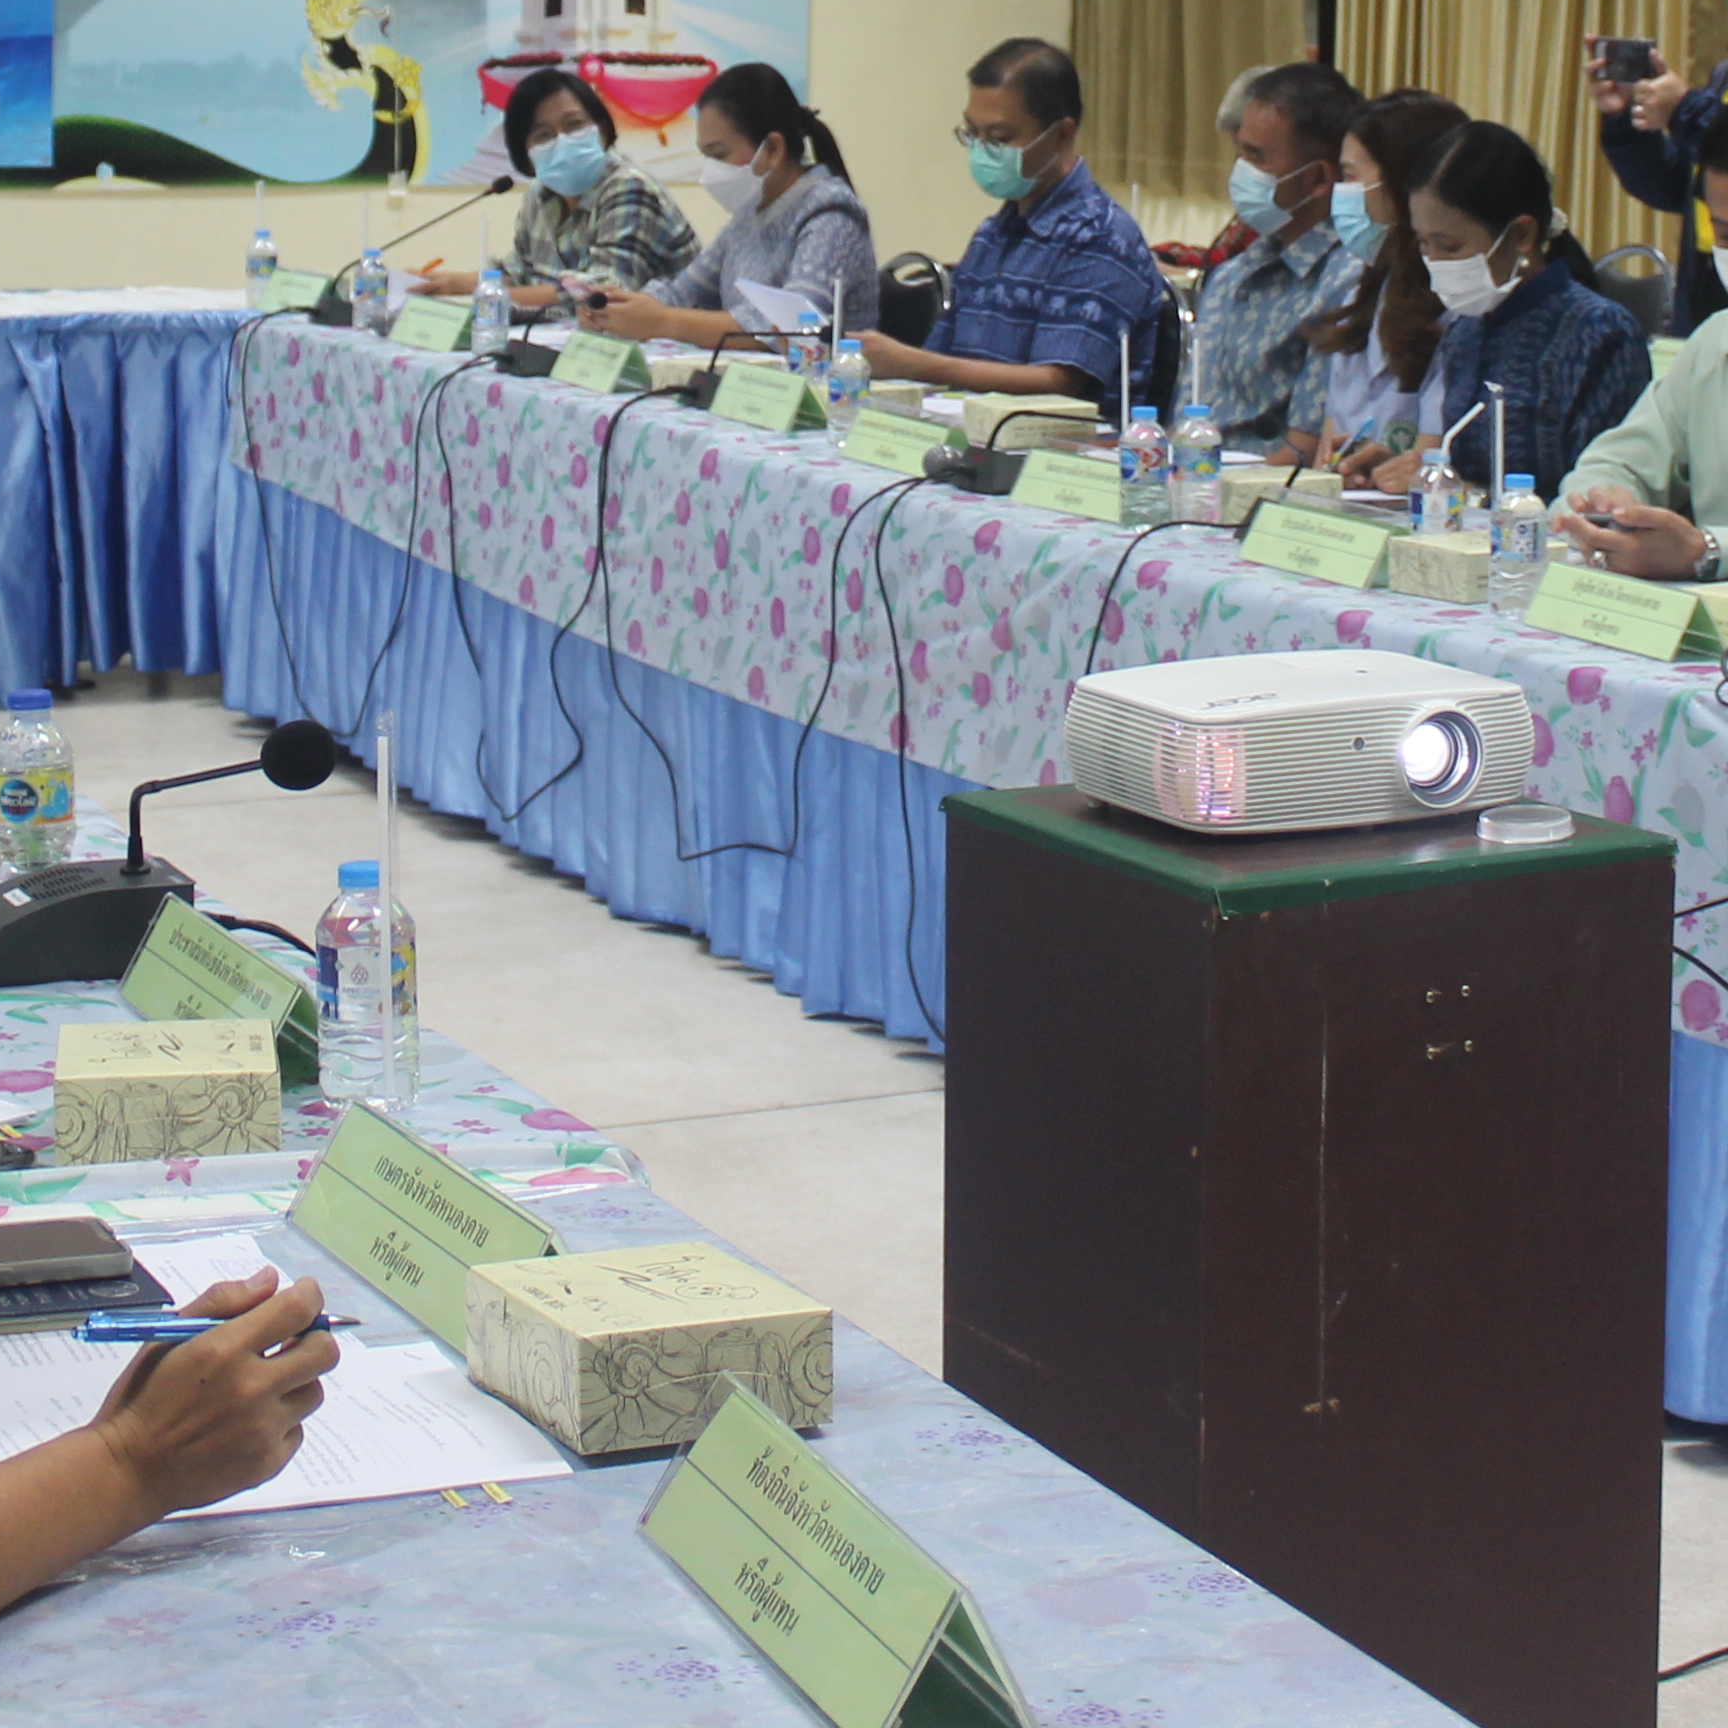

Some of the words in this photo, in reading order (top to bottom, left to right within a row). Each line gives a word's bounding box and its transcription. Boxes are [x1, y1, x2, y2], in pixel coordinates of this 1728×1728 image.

[373, 1155, 490, 1248] เกษตรจังหวัดหนองคาย
[369, 1230, 425, 1288] หรือผู้แทน
[746, 1445, 886, 1595] ท้องถิ่นจังหวัดหนองคาย
[734, 1557, 801, 1636] หรือผู้แทน
